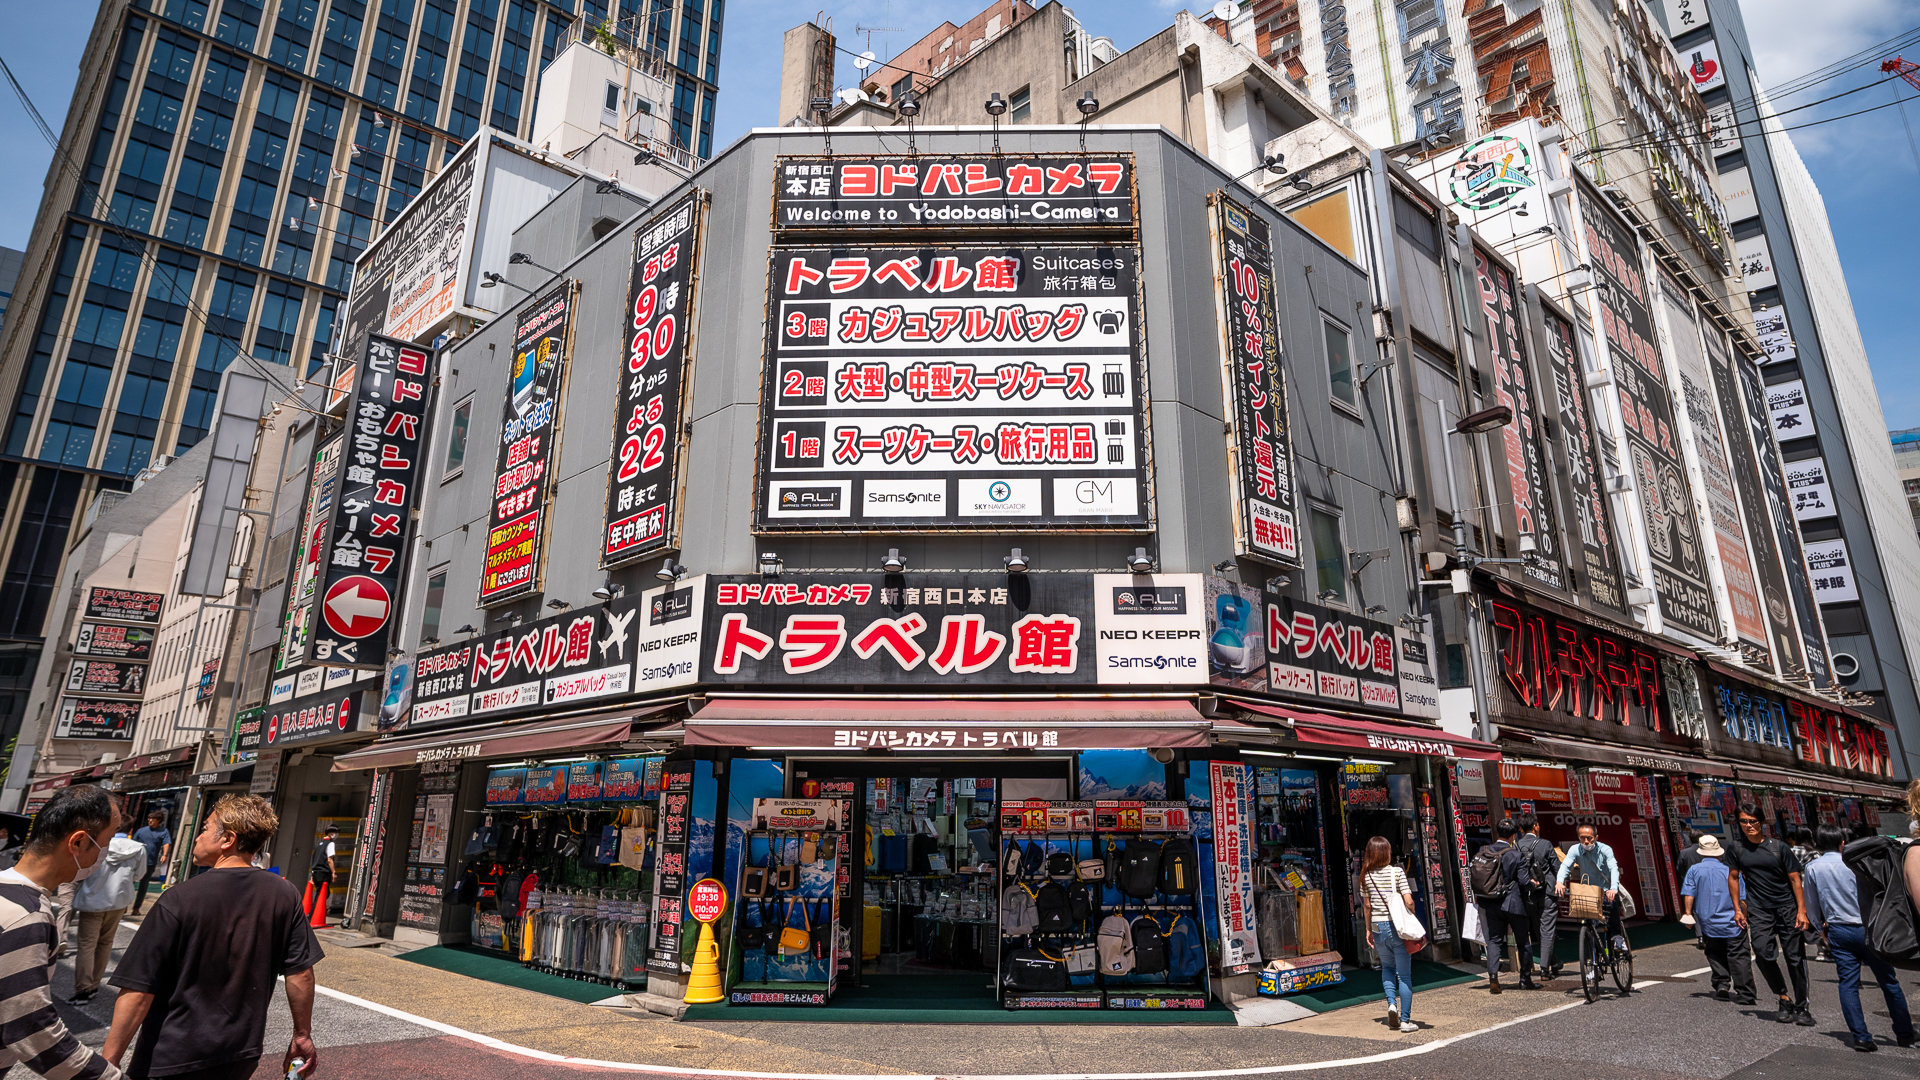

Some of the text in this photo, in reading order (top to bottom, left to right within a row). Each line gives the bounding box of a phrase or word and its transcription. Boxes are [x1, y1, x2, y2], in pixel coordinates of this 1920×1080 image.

[785, 165, 834, 176] 新宿西口
[840, 163, 1124, 196] ヨドバシカメラ
[786, 177, 831, 196] 本店
[375, 228, 401, 266] GOLD
[403, 192, 435, 236] POINT
[436, 162, 466, 205] CARD
[787, 201, 1118, 221] Welcome to Yodobashi-Camera
[639, 210, 690, 256] 営業時間
[1033, 255, 1124, 270] Suitcases
[1228, 239, 1245, 260] 全品
[642, 243, 679, 285] あさ
[786, 256, 1021, 294] トラベル館
[1043, 276, 1116, 291] 旅行箱包
[518, 299, 565, 339] ヨドバシドットコム
[634, 282, 679, 330] 9時
[786, 302, 1087, 343] 3階 カジュアルバッグ
[629, 314, 676, 374] 30
[629, 368, 668, 400] 分から
[784, 362, 1094, 402] 2階 大型・中型スーツケース
[1230, 257, 1275, 500] 10%ポイント還元
[1612, 351, 1648, 401] 豊富な
[504, 398, 552, 444] ネットで注文
[626, 394, 662, 435] よる
[1618, 387, 1677, 461] 品揃え
[1776, 413, 1802, 429] 本
[506, 434, 540, 469] 店舗で
[617, 424, 666, 483] 22
[780, 423, 1098, 464] 1階 スーツケース・旅行用品
[364, 348, 428, 575] ヨドバシカメラ
[496, 458, 544, 499] 受け取りが
[497, 484, 537, 518] できます
[618, 485, 657, 512] 時まで
[868, 492, 941, 504] Samsonite
[1076, 481, 1113, 503] GM
[1797, 491, 1819, 500] 家電
[1253, 503, 1291, 526] 入会金・年会費
[1795, 500, 1825, 511] ゲーム
[490, 519, 535, 548] 受取カウンターは
[610, 510, 663, 549] 年中無休
[1253, 516, 1293, 552] 無料!!
[485, 562, 530, 590] 1階にございます
[1815, 576, 1845, 589] 洋服
[94, 589, 161, 602] ヨドバシカメラ
[717, 584, 1008, 606] ヨドバシカメラ 新宿西口本店
[1654, 569, 1709, 613] ヨドバシカメラ
[92, 598, 159, 612] ゲーム・ホビー館
[640, 631, 697, 653] NEO KEEPR
[713, 612, 1081, 675] トラベル館
[1101, 630, 1200, 640] NEO KEEPR
[1268, 603, 1394, 677] トラベル館
[316, 638, 358, 663] すぐ
[417, 646, 469, 677] ヨドバシカメラ
[470, 615, 595, 688] トラベル館
[1109, 655, 1197, 669] Samsonite
[302, 671, 319, 684] HITACHI
[329, 669, 350, 681] Panasonic
[641, 660, 692, 682] Samsonite
[1400, 672, 1414, 681] NEO
[276, 684, 292, 695] DAIKIN
[417, 673, 464, 697] 新宿西口本店
[556, 674, 606, 698] カジュアルバッグ
[1274, 666, 1396, 705] スーツケース 旅行バッグ カジュアルバッグ
[418, 702, 450, 719] スーツケース
[482, 688, 519, 709] 旅行バッグ
[1404, 692, 1436, 706] Samsonite
[74, 713, 105, 724] ゲーム
[281, 703, 335, 735] 搬入車出入口
[1718, 684, 1792, 750] 新宿西口
[1464, 769, 1482, 778] mobile
[1595, 772, 1621, 788] docomo
[820, 782, 854, 792] トラベル館
[1348, 789, 1386, 804] ビジネスバッグ
[769, 817, 824, 827] ミニショルダー
[1235, 766, 1253, 931] 冷蔵庫・洗濯機・テレビ
